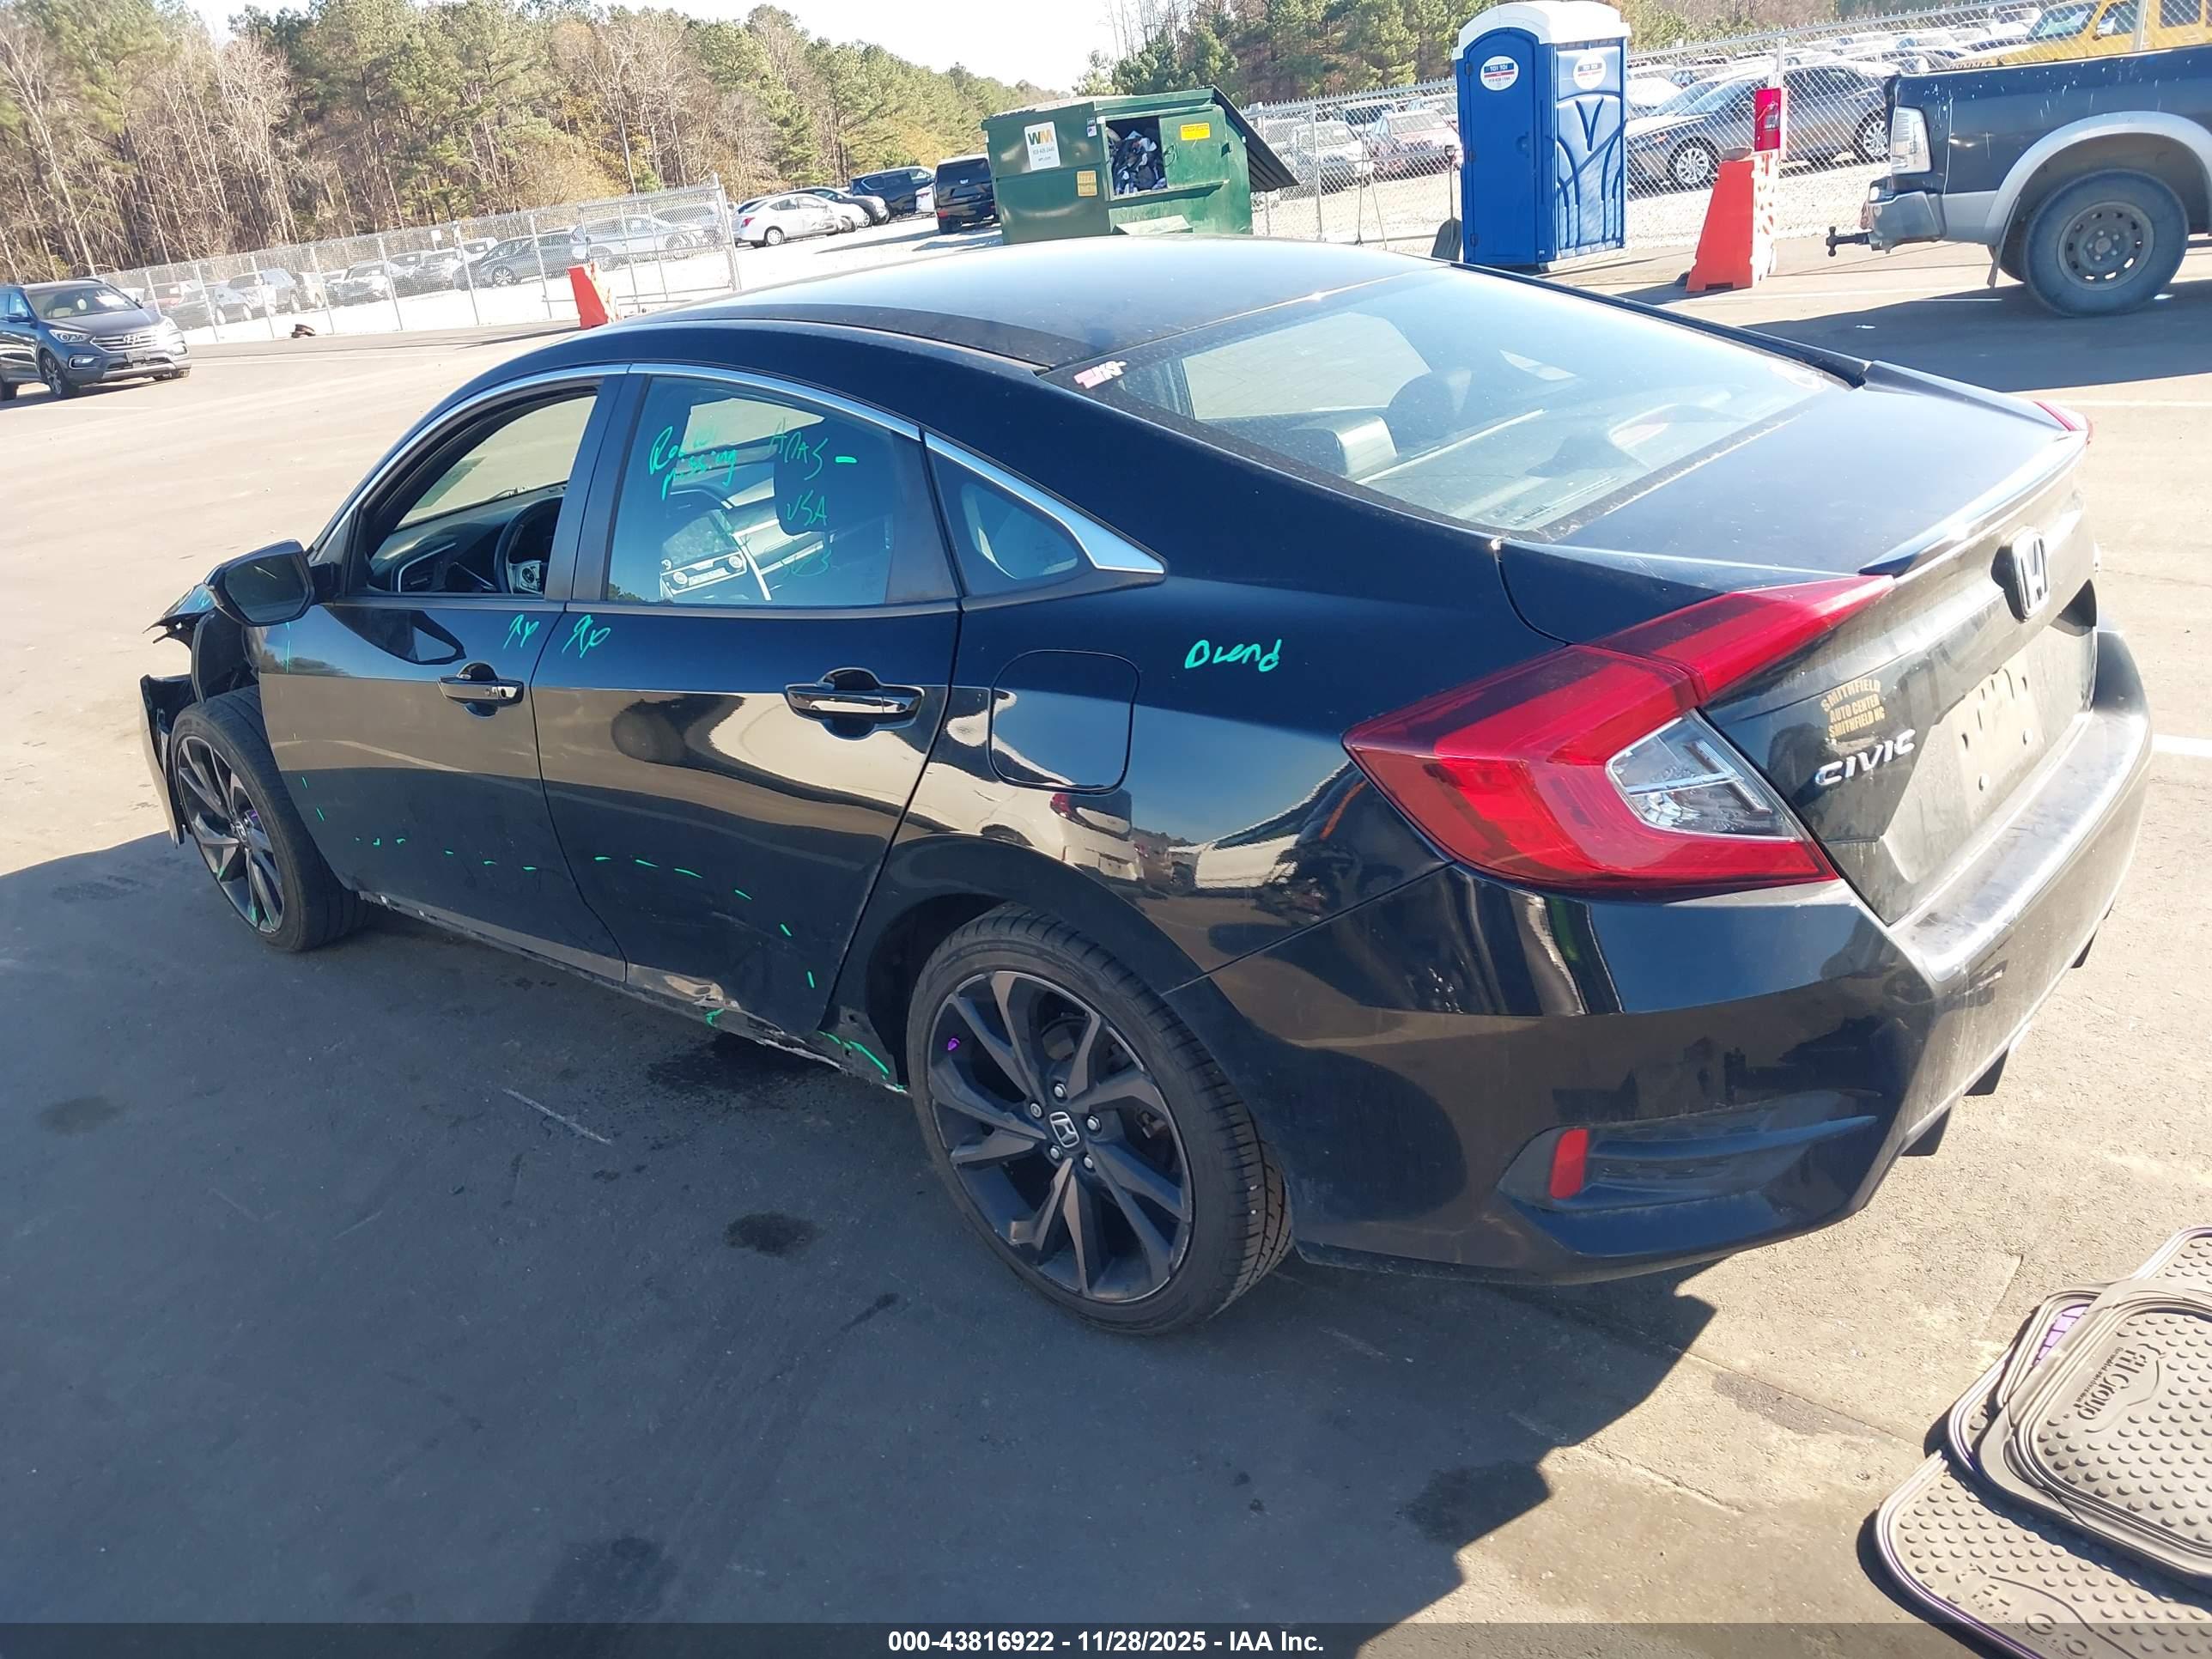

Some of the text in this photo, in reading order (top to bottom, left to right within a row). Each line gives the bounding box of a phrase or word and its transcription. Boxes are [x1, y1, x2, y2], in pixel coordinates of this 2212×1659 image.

[1028, 129, 1054, 146] WM
[1820, 678, 1881, 713] SMITHFIELD
[1830, 693, 1881, 723] AUTO CENTER
[1828, 709, 1875, 738] SMITHFIELD
[1814, 728, 1917, 786] CIVIC
